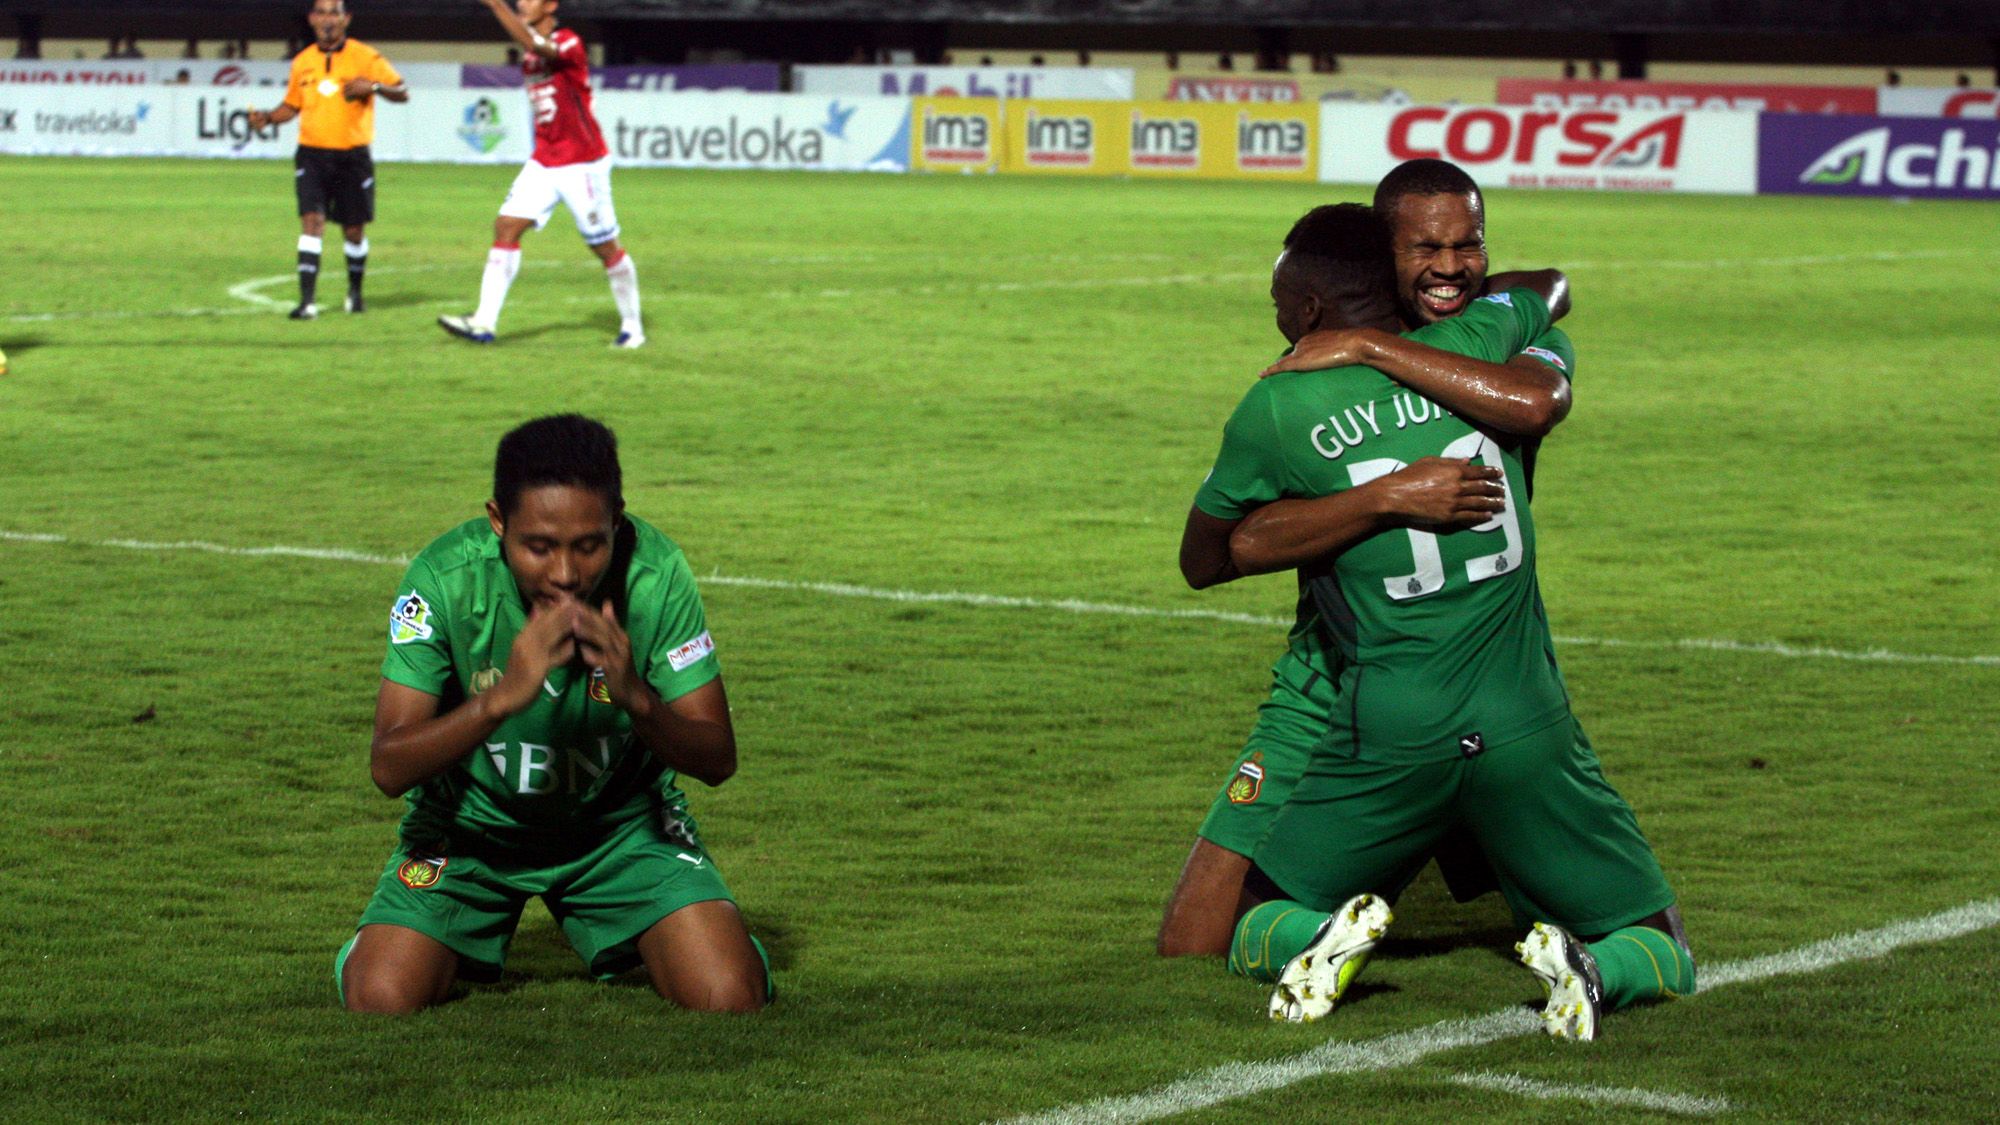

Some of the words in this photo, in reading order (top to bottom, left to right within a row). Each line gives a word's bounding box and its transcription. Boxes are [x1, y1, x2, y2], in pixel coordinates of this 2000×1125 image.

[35, 108, 137, 134] traveloka
[615, 115, 822, 162] traveloka
[925, 106, 988, 147] im3
[1028, 109, 1092, 149] im3
[1132, 111, 1197, 151] im3
[1239, 112, 1305, 154] im3
[1310, 400, 1382, 460] GUY
